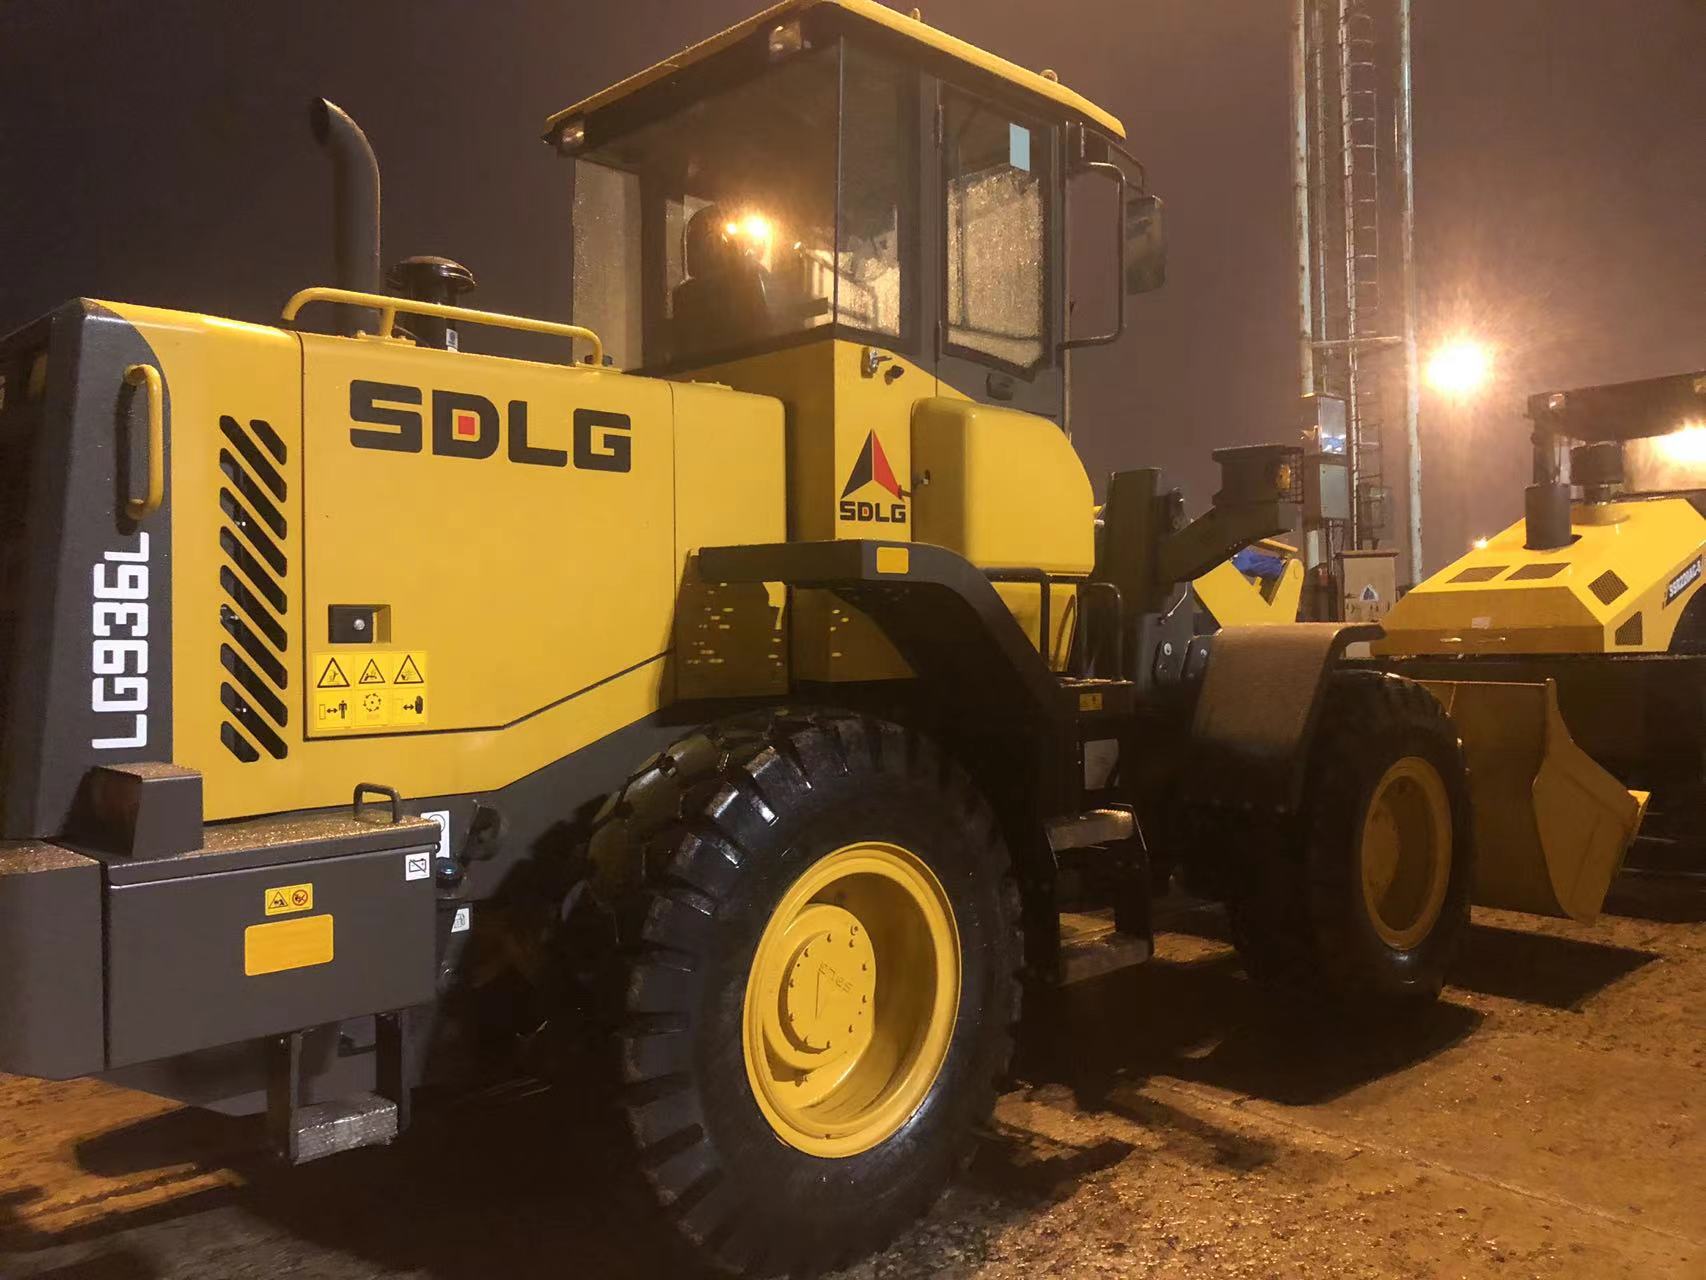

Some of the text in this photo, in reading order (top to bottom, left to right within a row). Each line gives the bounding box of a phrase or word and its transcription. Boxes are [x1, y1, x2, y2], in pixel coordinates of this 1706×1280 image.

[350, 379, 631, 473] SDLG
[840, 501, 906, 523] SDLG
[92, 532, 150, 749] LG936L
